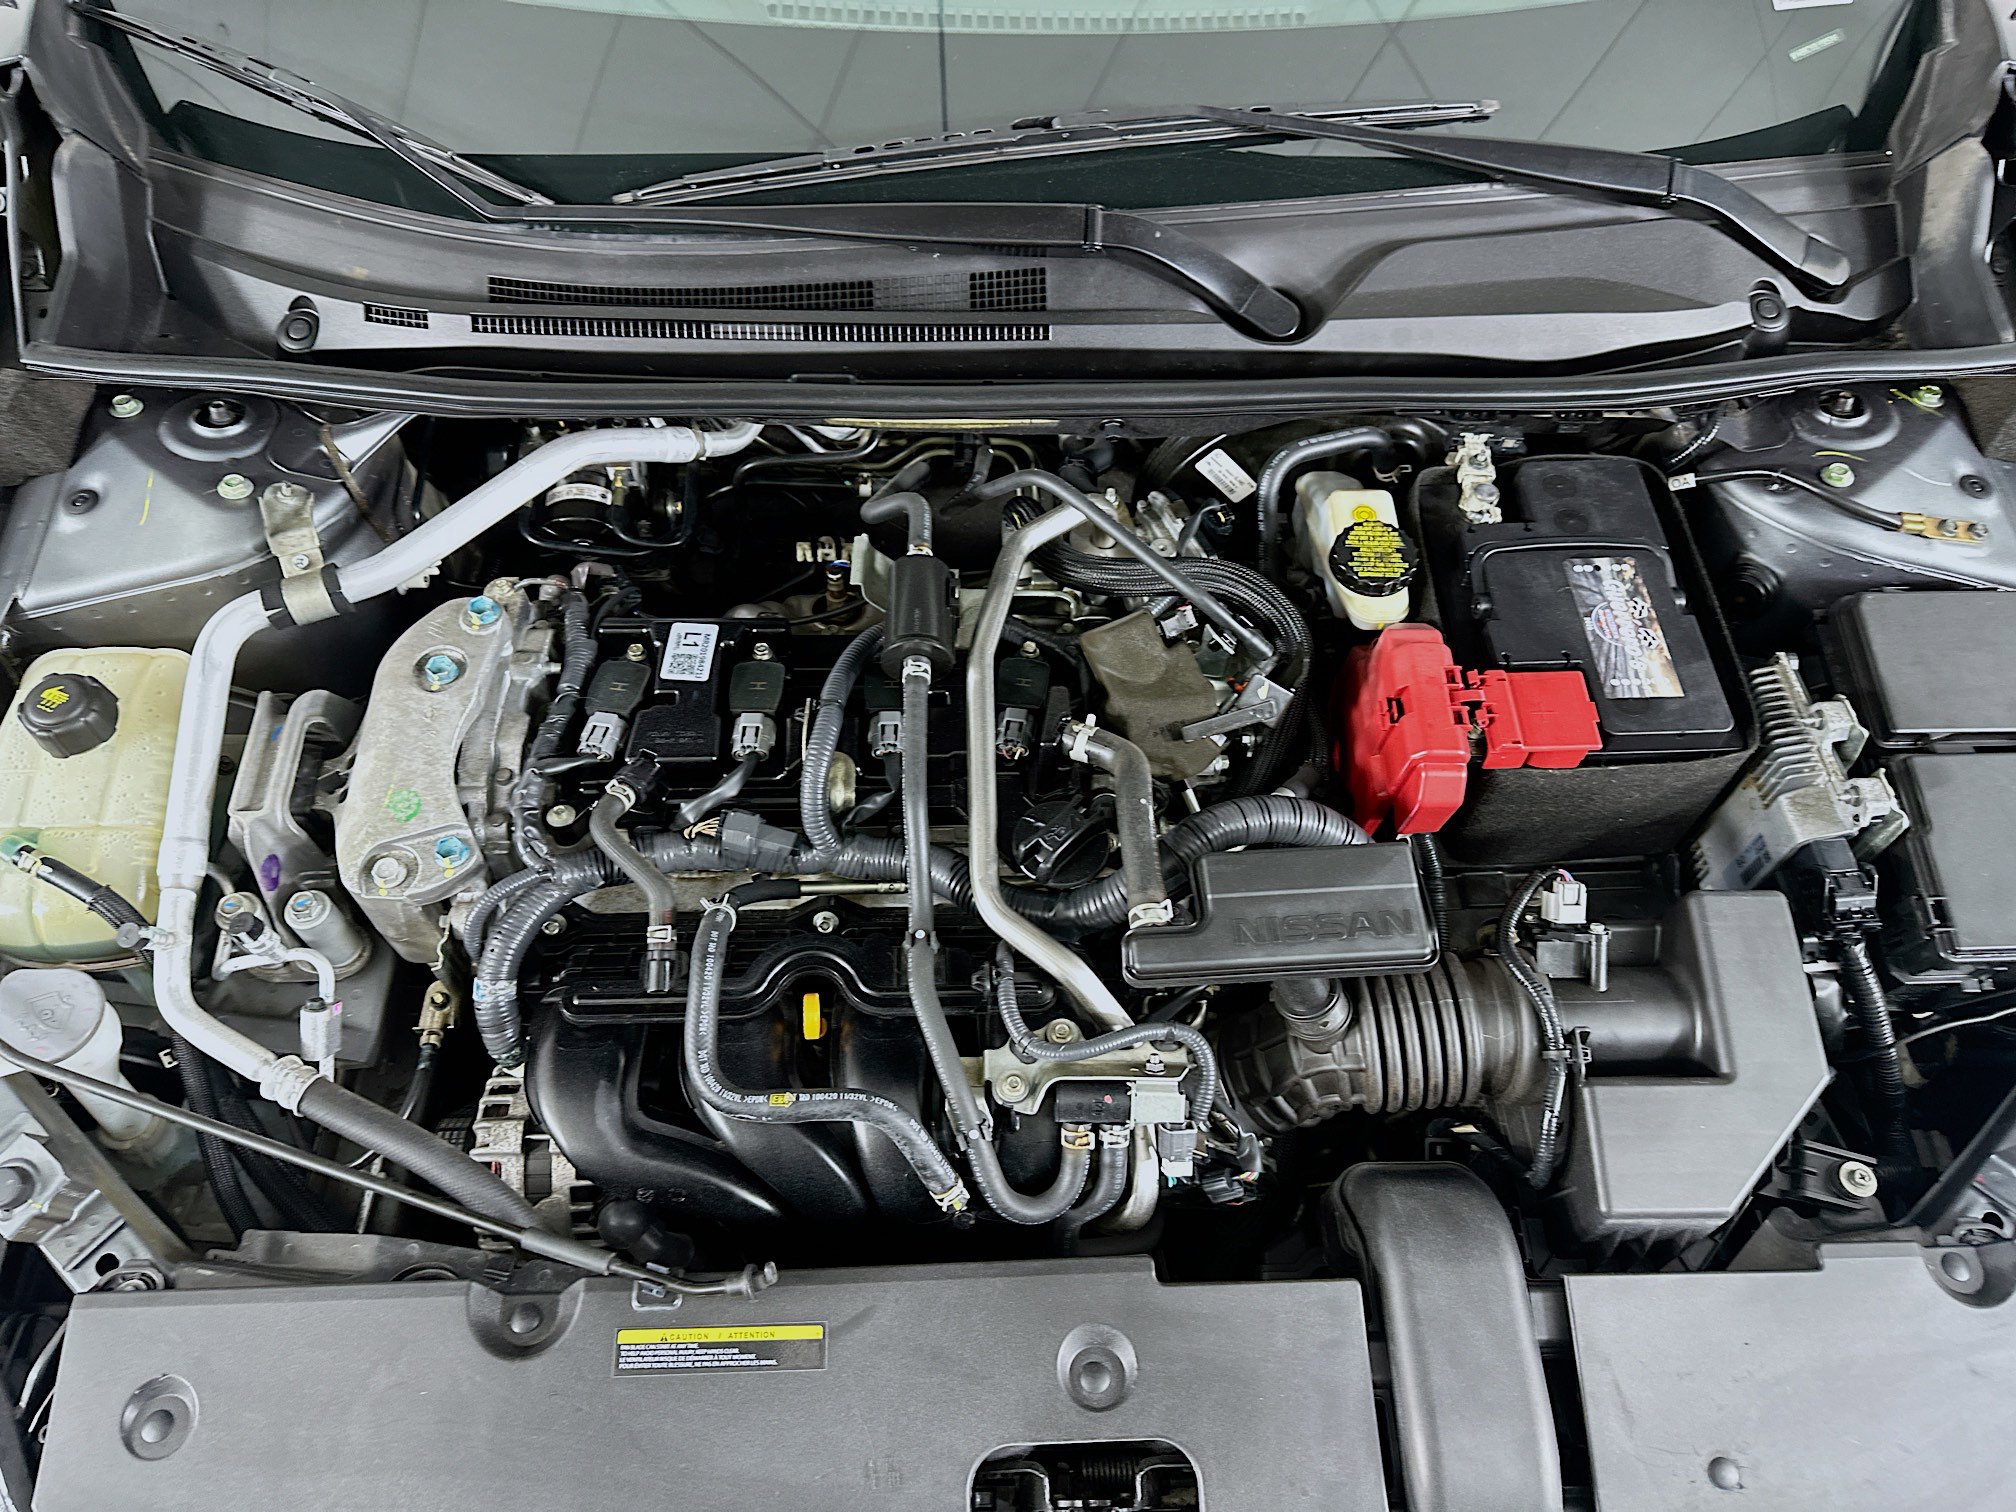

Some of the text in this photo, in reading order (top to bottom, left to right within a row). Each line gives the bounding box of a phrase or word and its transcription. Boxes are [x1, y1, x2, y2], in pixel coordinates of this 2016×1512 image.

[683, 632, 702, 646] L1
[1231, 909, 1418, 947] NISSAN
[669, 1332, 709, 1341] CAUTION
[727, 1331, 776, 1339] ATTENTION
